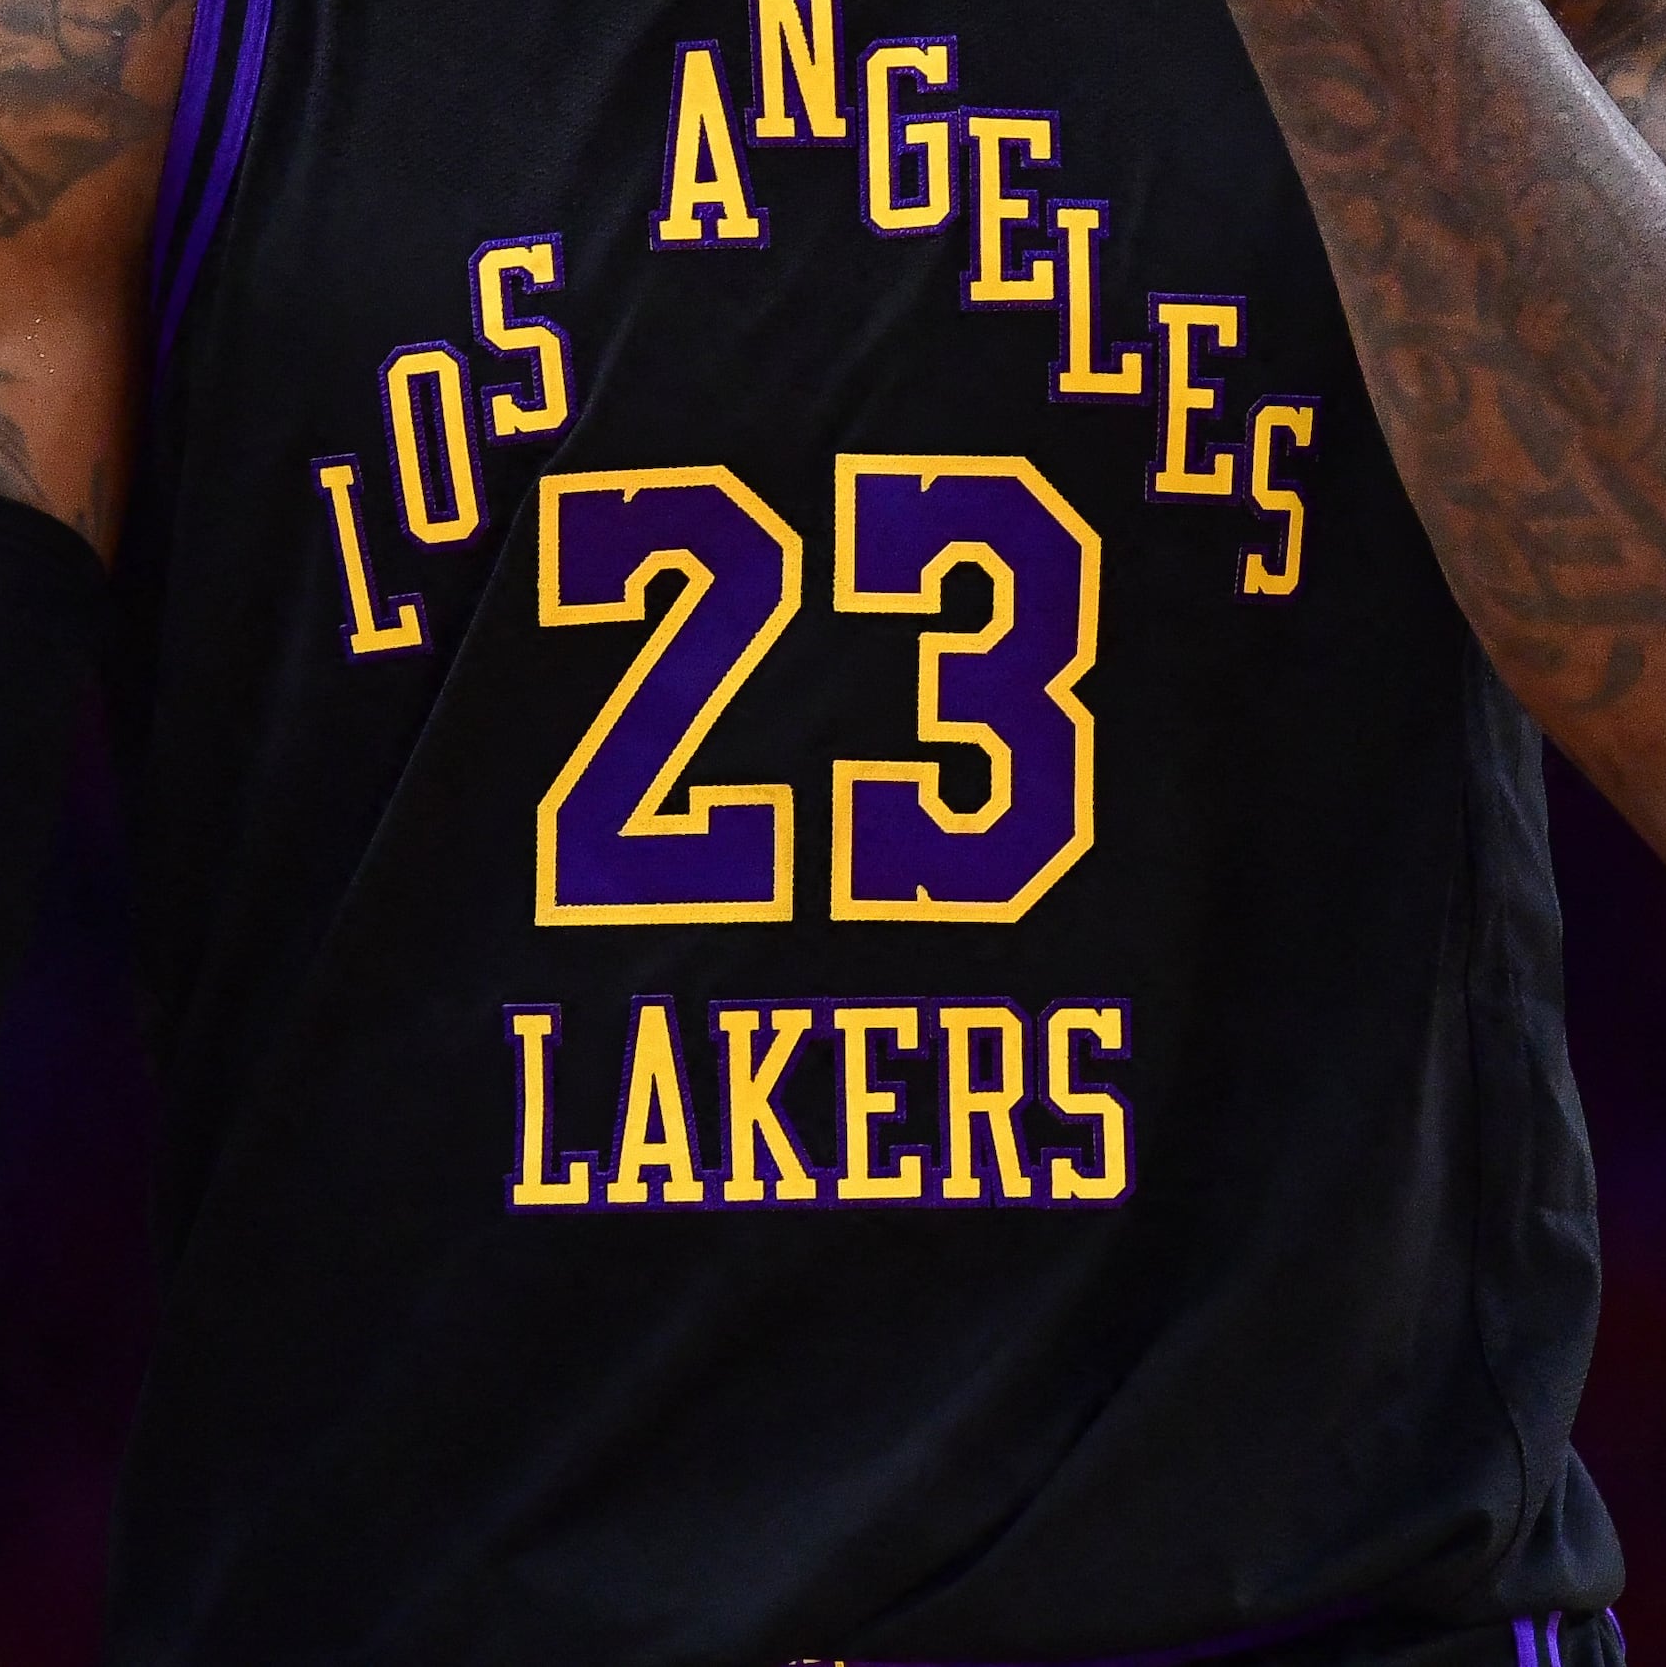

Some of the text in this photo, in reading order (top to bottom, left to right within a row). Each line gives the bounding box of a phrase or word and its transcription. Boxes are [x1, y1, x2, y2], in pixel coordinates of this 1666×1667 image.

[312, 234, 577, 658] LOS
[535, 452, 1101, 926] 23
[504, 995, 1133, 1215] LAKERS
